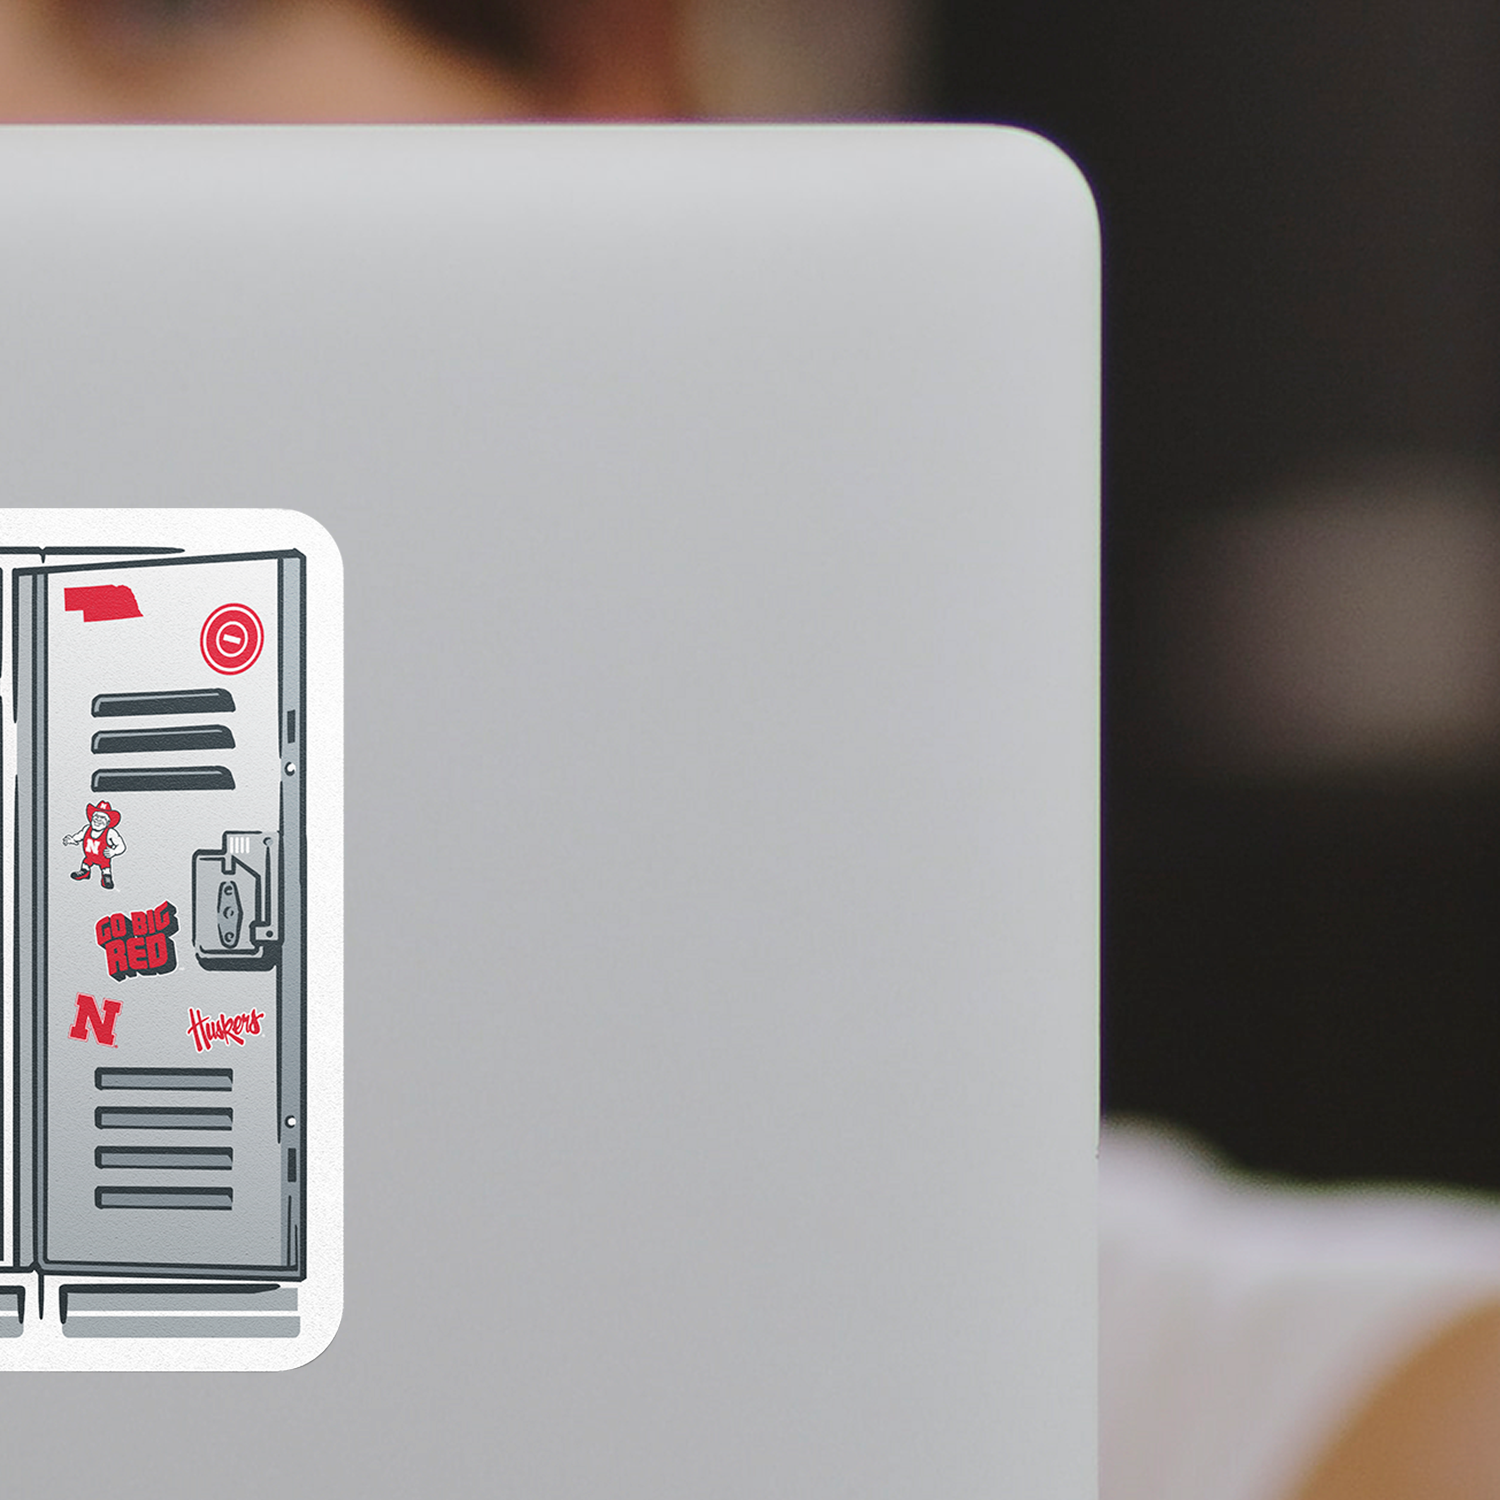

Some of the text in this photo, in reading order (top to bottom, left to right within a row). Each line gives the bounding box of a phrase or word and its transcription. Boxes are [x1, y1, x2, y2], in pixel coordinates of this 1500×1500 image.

[85, 838, 101, 855] N
[95, 900, 171, 946] GO BIG
[105, 932, 169, 976] RED
[68, 992, 123, 1046] N
[187, 1008, 265, 1052] Huskers
